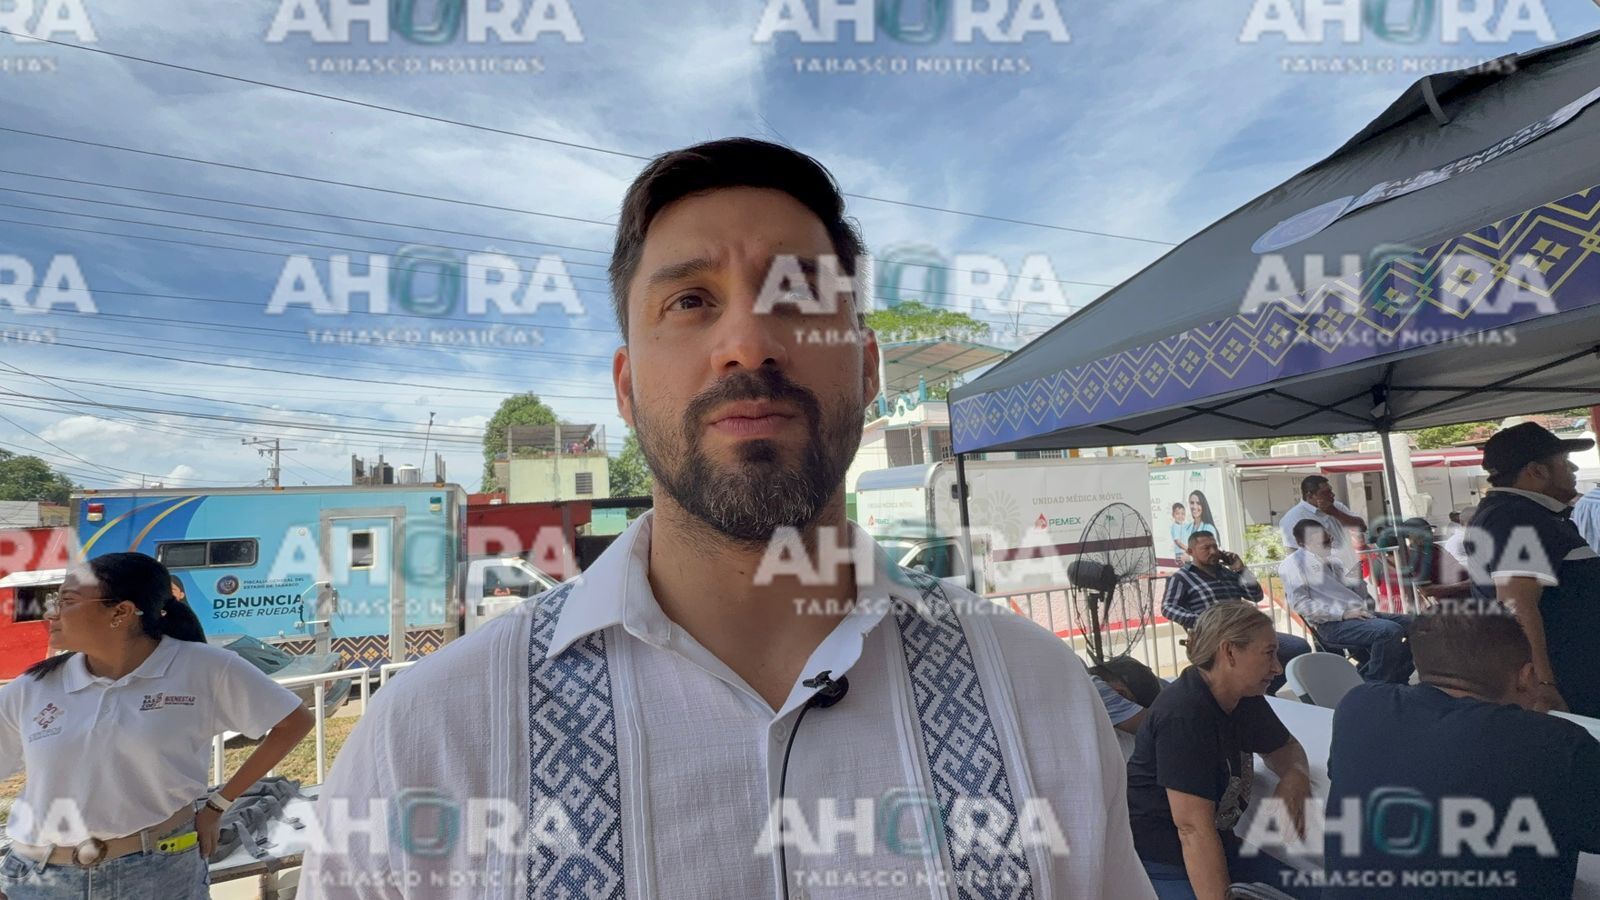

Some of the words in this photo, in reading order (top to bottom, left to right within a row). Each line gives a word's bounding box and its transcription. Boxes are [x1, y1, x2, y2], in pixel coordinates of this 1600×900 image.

[1032, 496, 1065, 506] UNIDAD
[1048, 517, 1081, 527] PEMEX
[213, 594, 302, 610] DENUNCIA
[212, 608, 253, 620] SOBRE
[256, 606, 303, 617] RUEDAS
